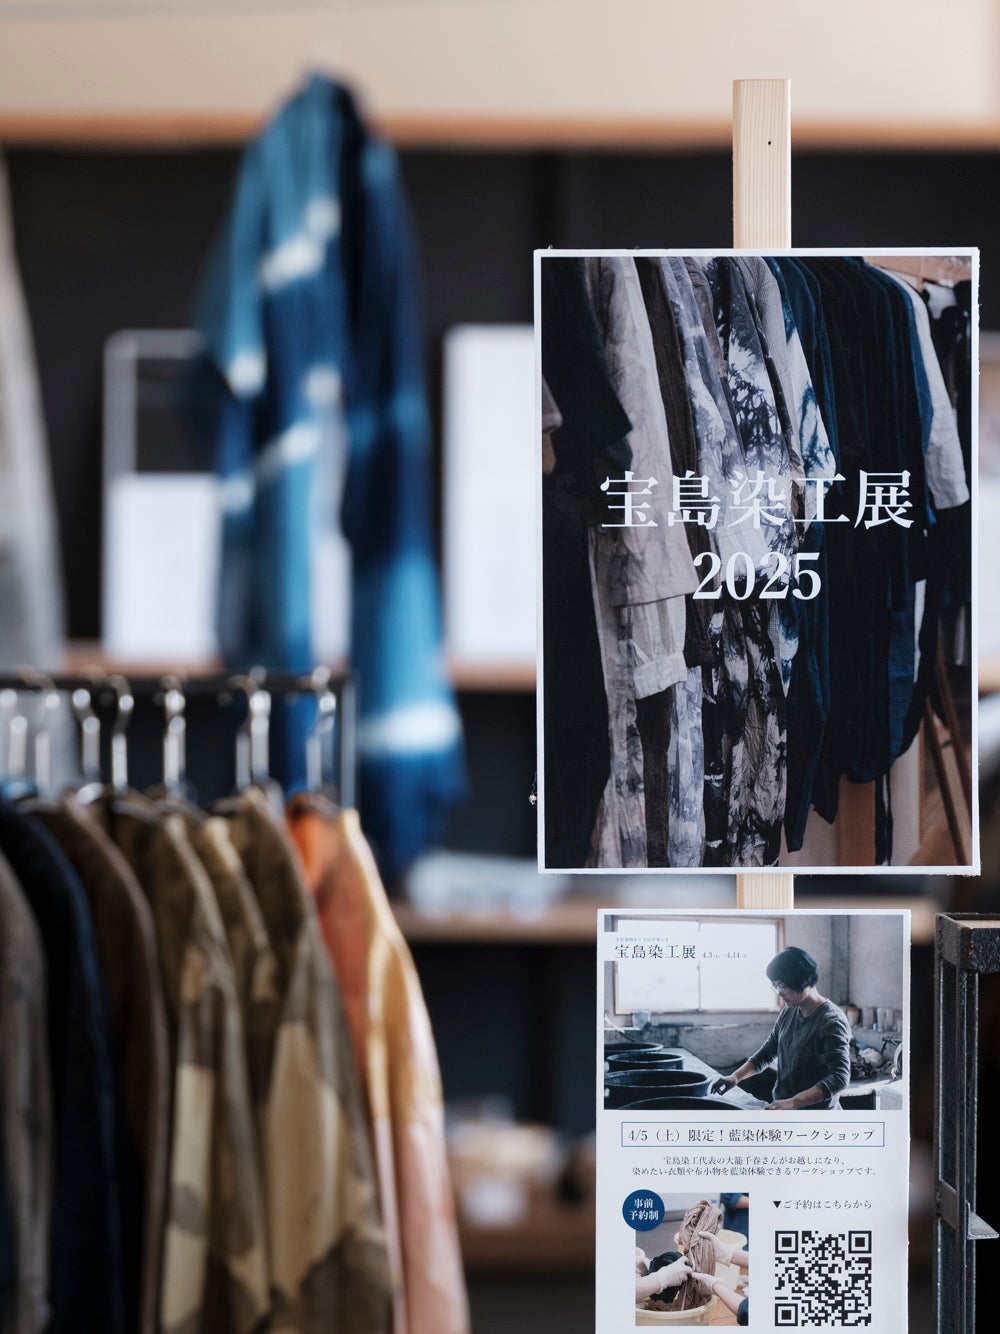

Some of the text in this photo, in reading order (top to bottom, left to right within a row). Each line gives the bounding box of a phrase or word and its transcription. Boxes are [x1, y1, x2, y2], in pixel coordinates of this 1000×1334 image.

[599, 469, 915, 530] 宝島染工展
[691, 551, 822, 600] 2025
[614, 944, 696, 959] 宝島染工展
[634, 1197, 654, 1209] 事前
[628, 1209, 659, 1221] 予約制
